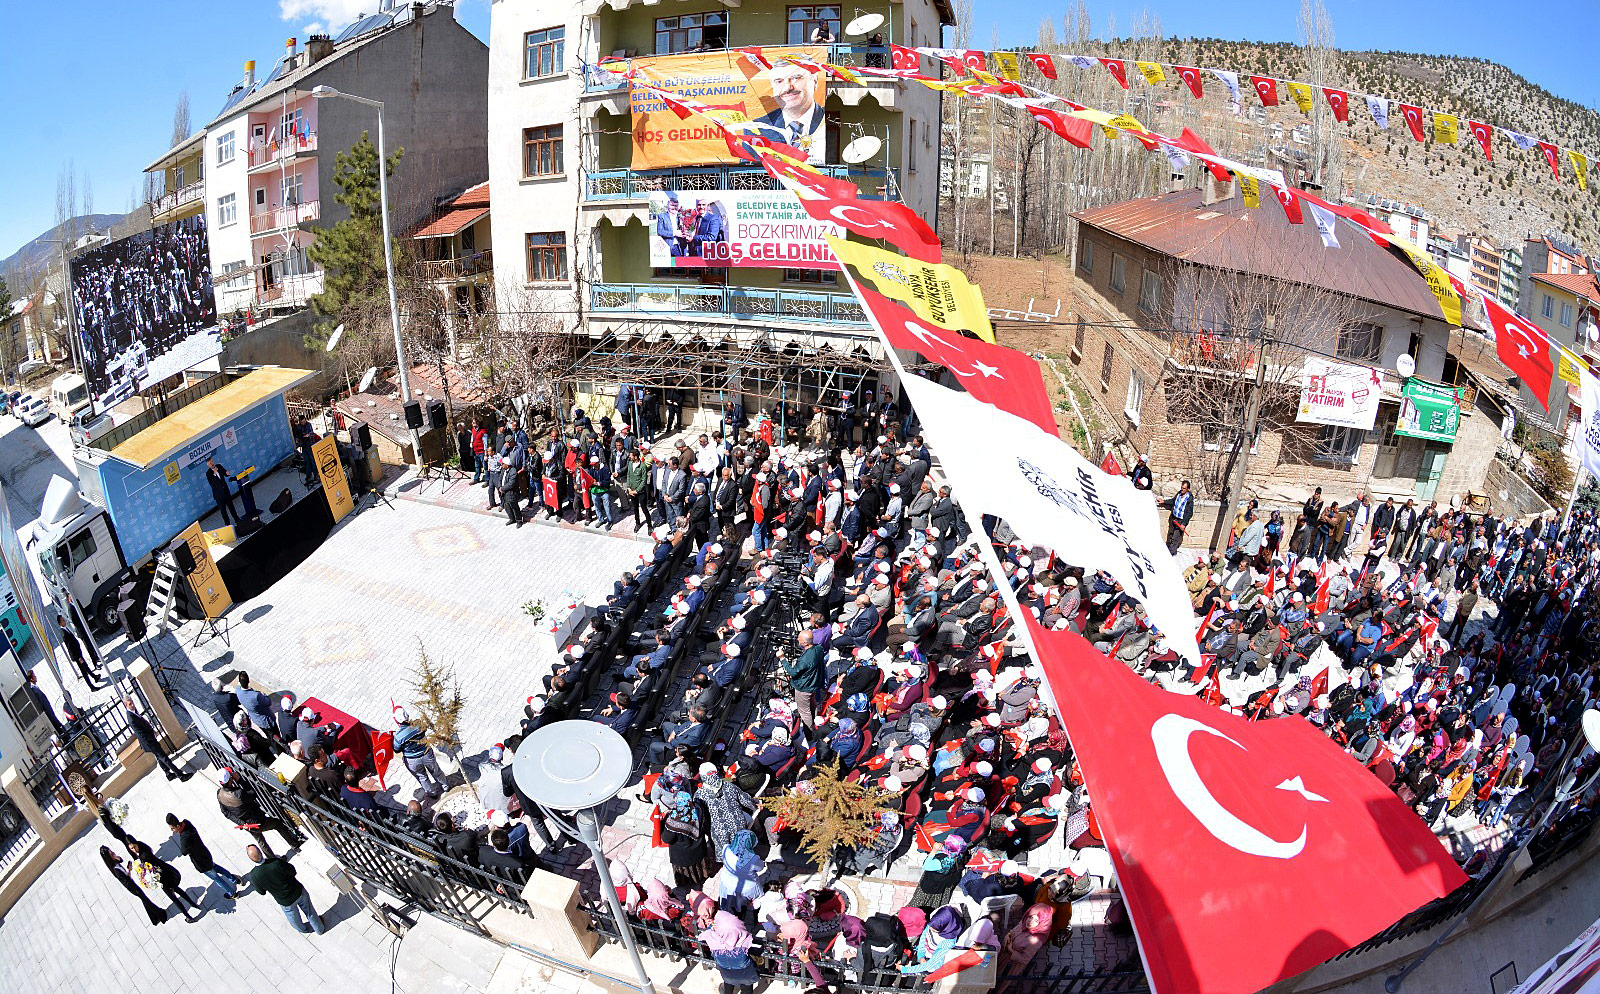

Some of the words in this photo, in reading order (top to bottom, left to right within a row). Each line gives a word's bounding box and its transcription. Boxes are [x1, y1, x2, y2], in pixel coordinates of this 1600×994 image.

[632, 79, 661, 90] SAN
[665, 74, 731, 87] BÜYÜKŞEHİR
[637, 130, 664, 145] HOŞ
[668, 125, 726, 141] GELDİN
[737, 201, 777, 210] BELEDİYE
[737, 212, 763, 220] SAYIN
[766, 210, 792, 220] TAHİR
[703, 243, 743, 263] HOŞ
[909, 274, 926, 300] KONYA
[920, 267, 946, 323] BÜYÜKŞEHİR
[939, 280, 956, 312] BELEDİYESİ
[1309, 375, 1326, 393] 51
[1307, 393, 1345, 407] YATIRIM
[189, 441, 212, 460] BOZKIR
